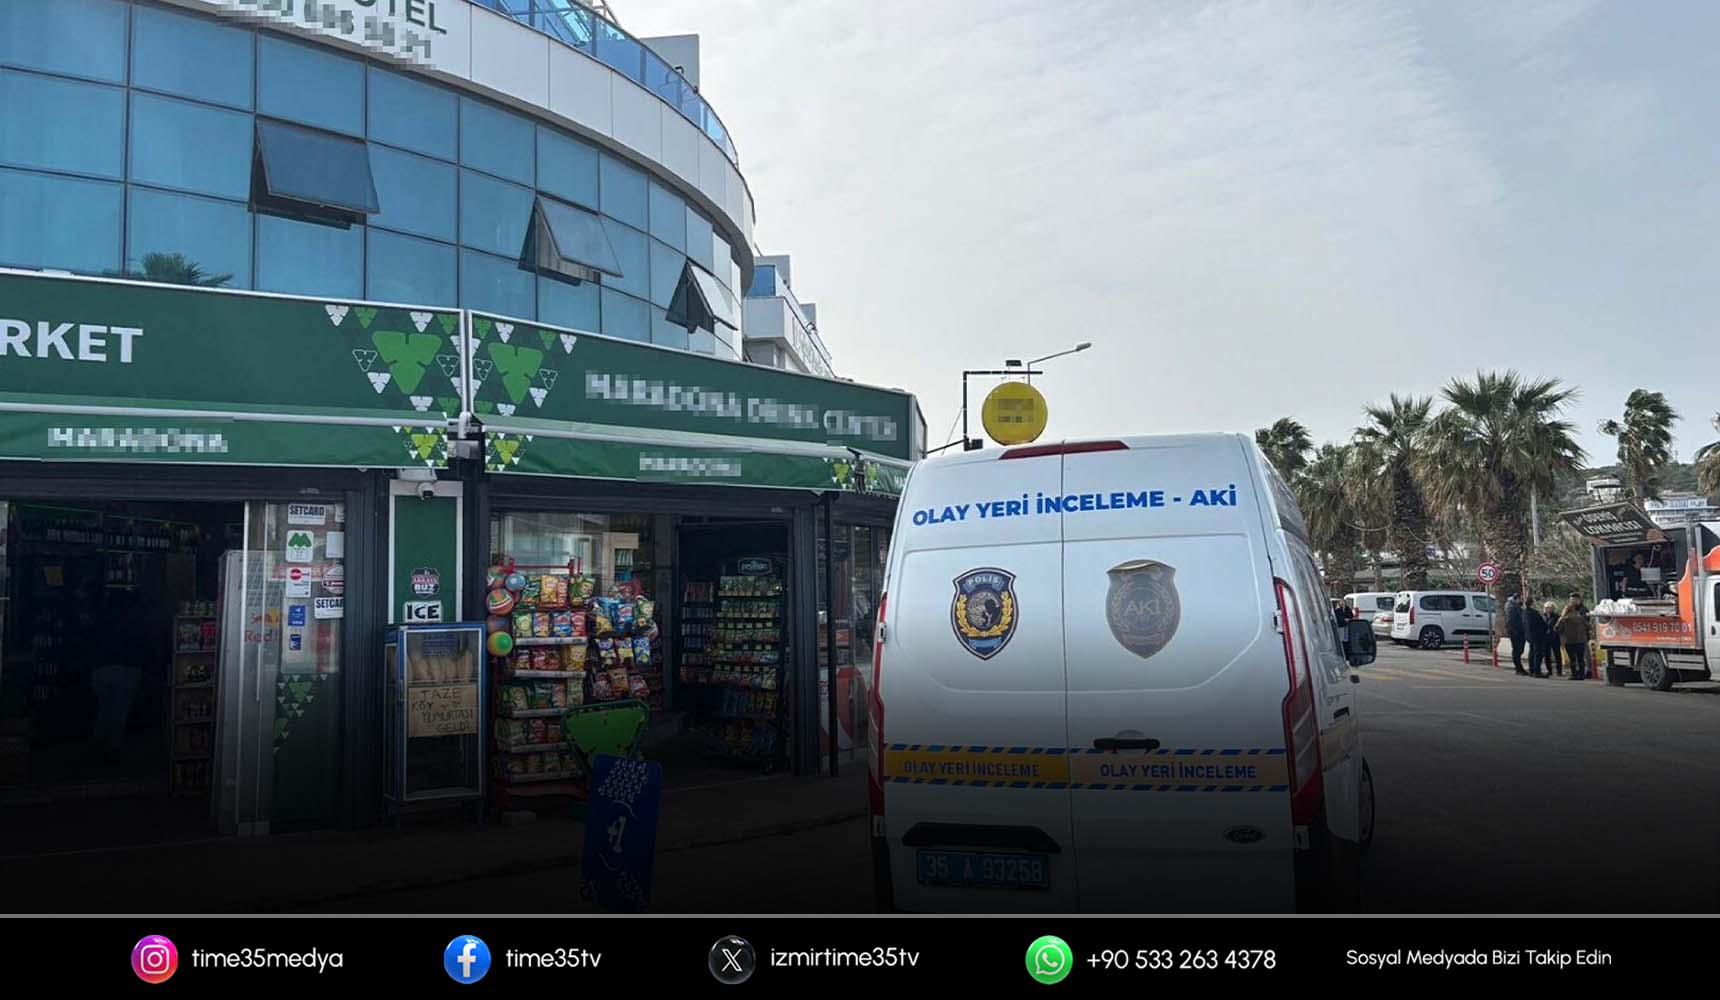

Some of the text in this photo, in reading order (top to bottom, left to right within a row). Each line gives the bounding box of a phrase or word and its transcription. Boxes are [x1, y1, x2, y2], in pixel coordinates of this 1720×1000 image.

[0, 319, 144, 363] RKET
[289, 504, 325, 517] SETCARD
[912, 504, 970, 526] OLAY
[976, 494, 1029, 518] YERİ
[1036, 491, 1165, 514] İNCELEME
[1189, 484, 1237, 507] AKİ
[1481, 568, 1494, 578] 50
[407, 604, 440, 620] ICE
[904, 760, 1040, 777] OLAY YERİ İNCELEME
[1101, 763, 1257, 779] OLAY YERİ İNCELEME
